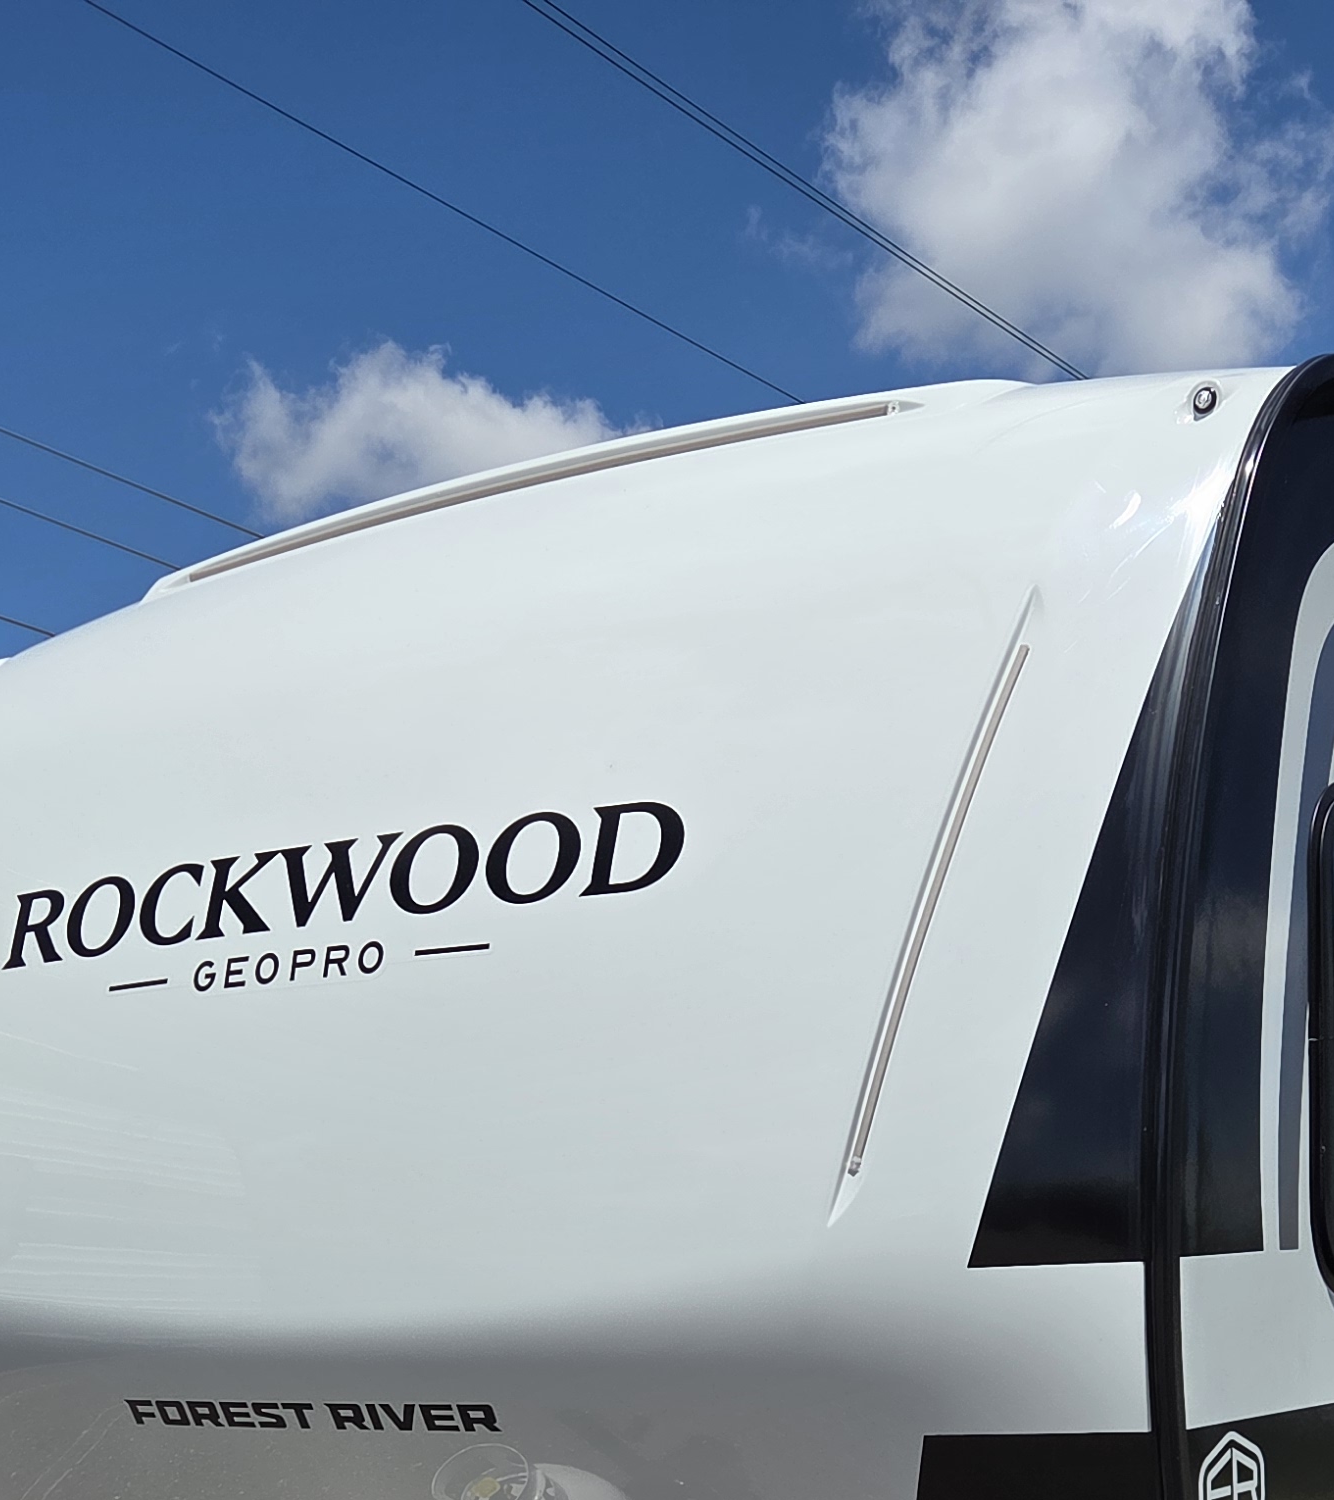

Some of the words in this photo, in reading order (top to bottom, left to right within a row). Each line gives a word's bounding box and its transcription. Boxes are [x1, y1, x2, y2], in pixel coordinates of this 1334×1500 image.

[1, 801, 685, 970] ROCKWOOD
[192, 941, 385, 993] GEOPRO
[124, 1399, 314, 1430] FOREST
[323, 1403, 503, 1433] RIVER
